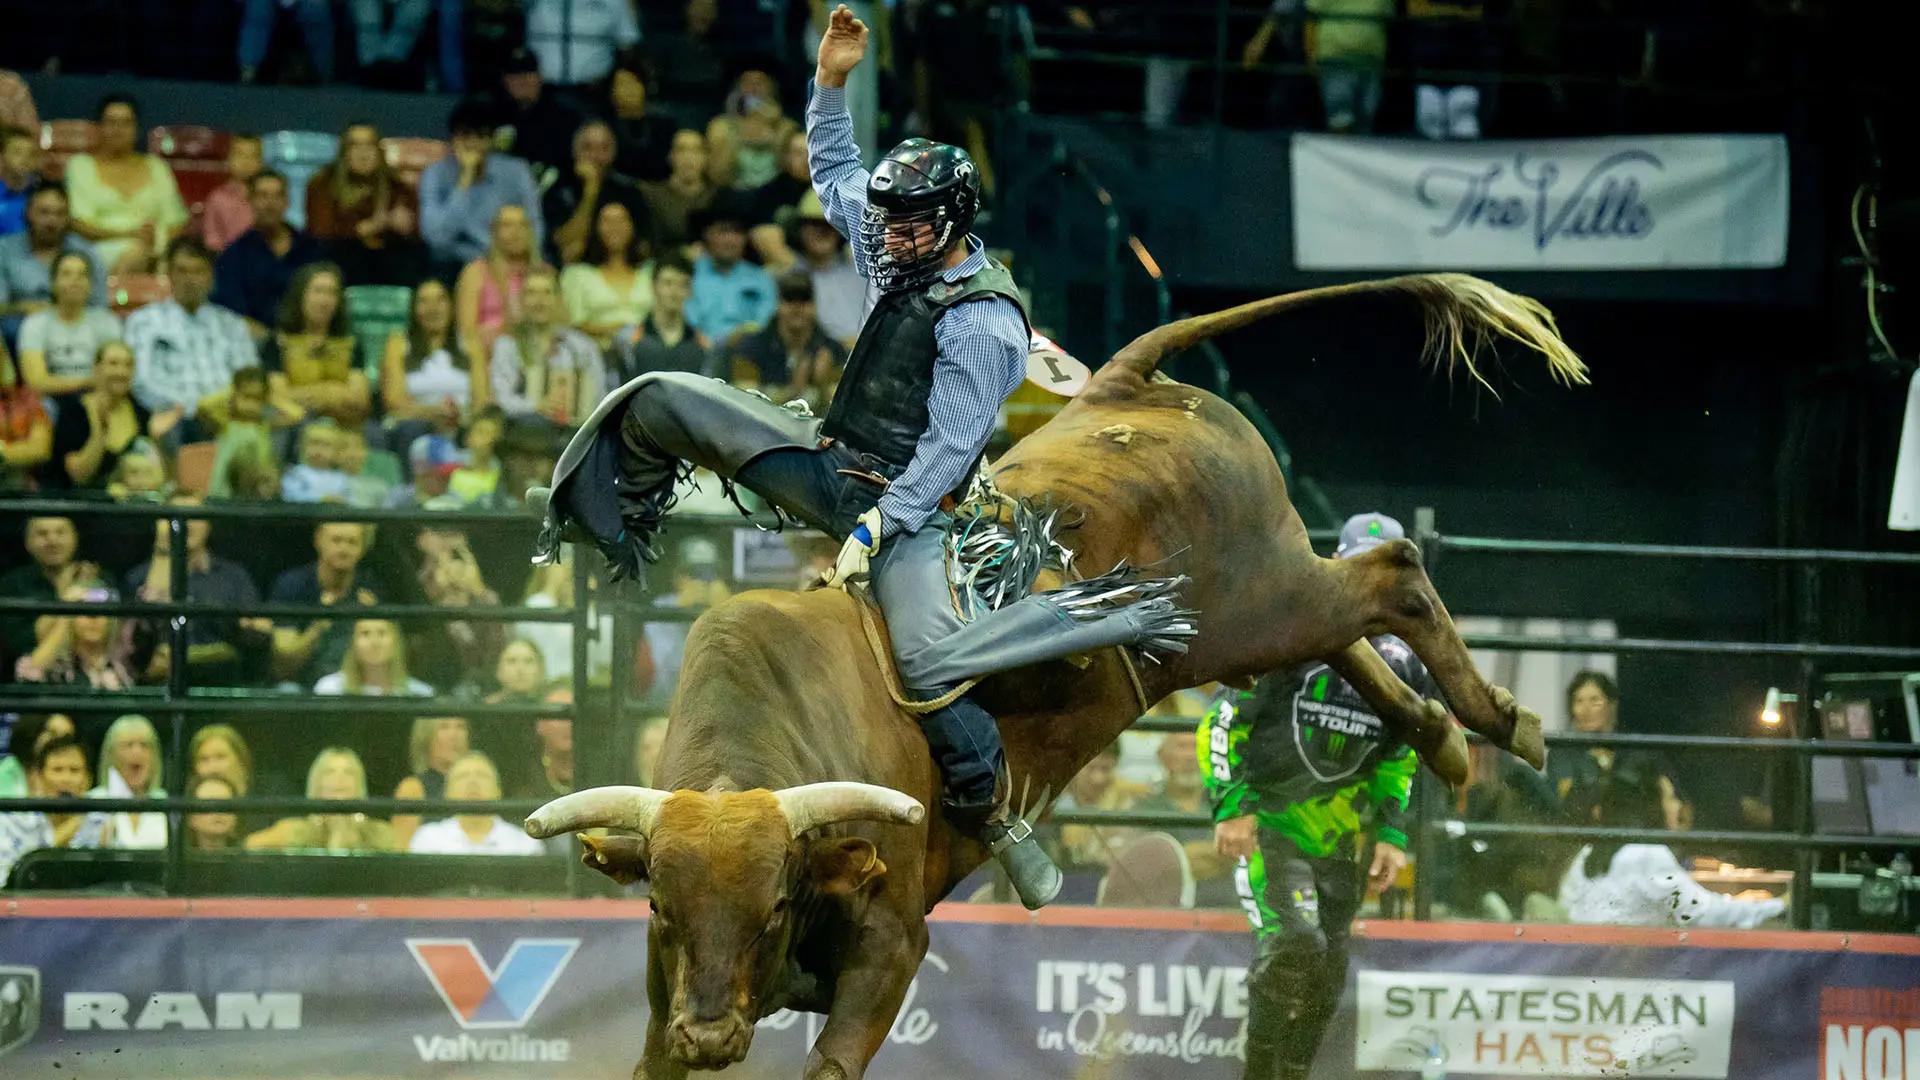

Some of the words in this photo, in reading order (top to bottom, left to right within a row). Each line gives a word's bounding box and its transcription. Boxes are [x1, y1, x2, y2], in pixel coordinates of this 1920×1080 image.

[1416, 160, 1529, 238] The
[1513, 149, 1665, 251] Ville
[1298, 699, 1351, 718] MONSTER
[1317, 713, 1368, 737] TOUR
[1036, 960, 1128, 1015] IT'S
[1138, 963, 1249, 1018] LIVE
[1384, 985, 1708, 1027] STATESMAN
[63, 991, 303, 1031] RAM
[412, 1031, 573, 1064] Valvoline
[1036, 1026, 1065, 1051] in
[1066, 1002, 1249, 1064] Queensland
[1474, 1029, 1618, 1067] HATS
